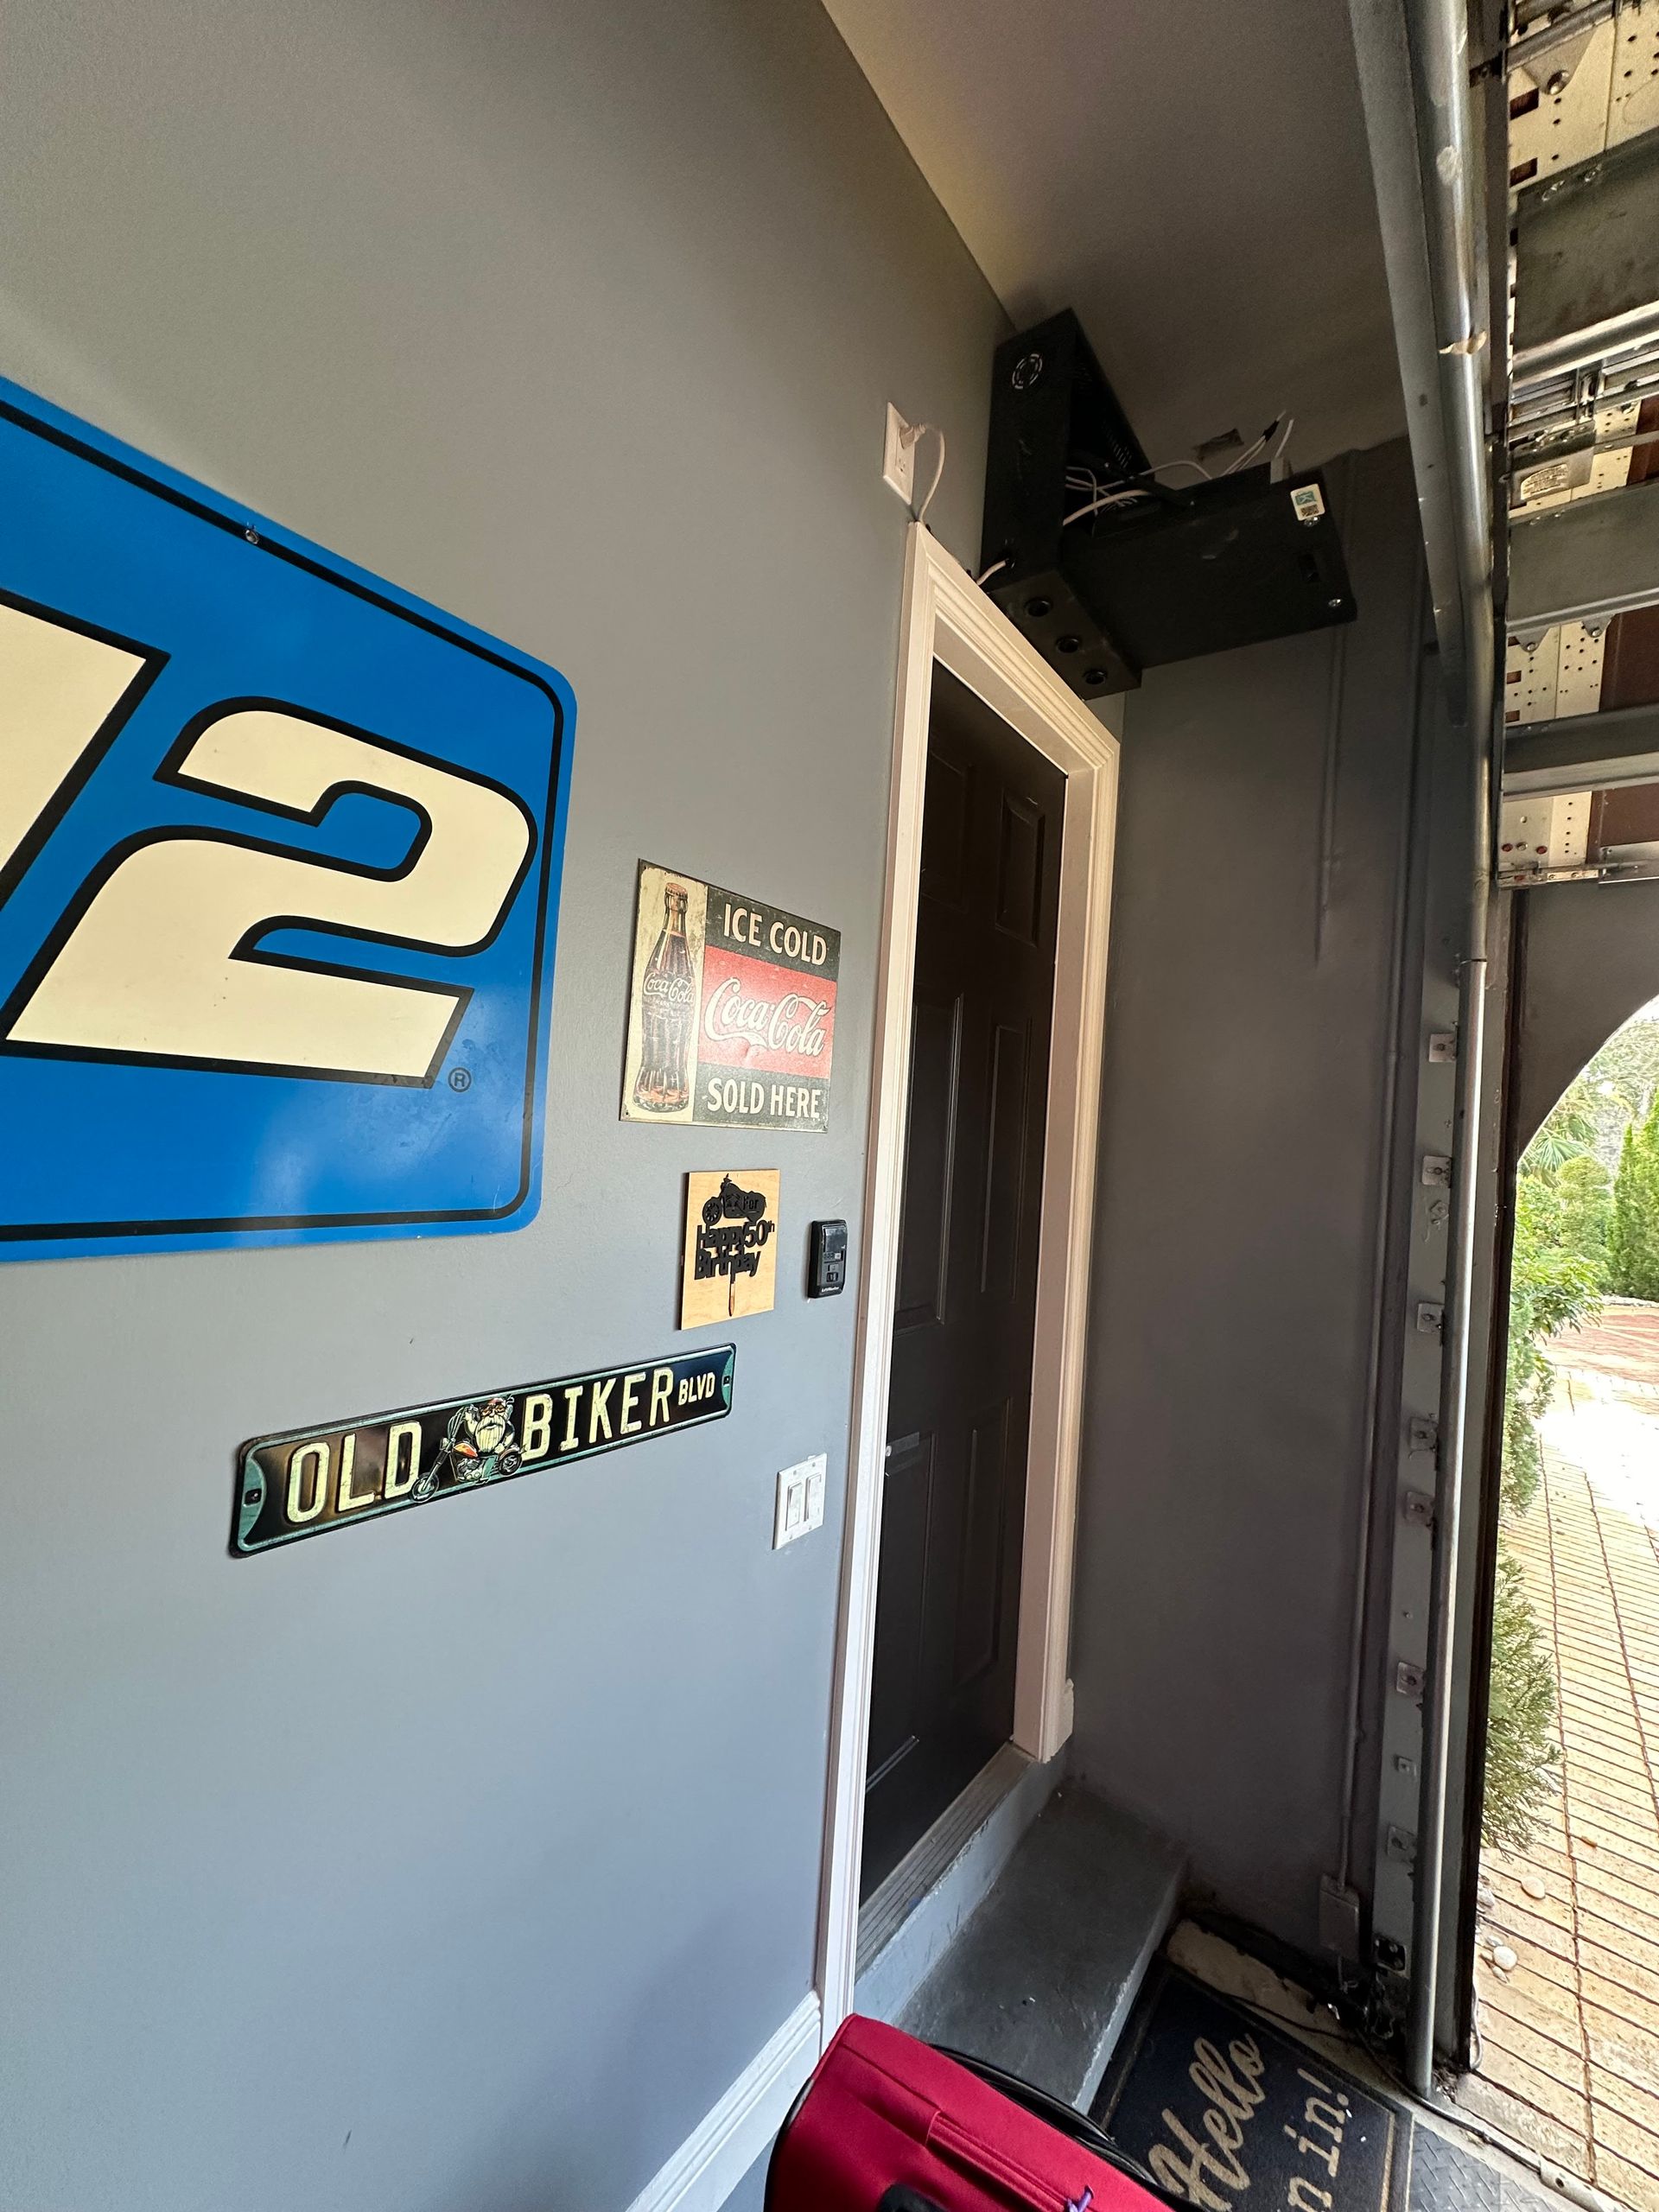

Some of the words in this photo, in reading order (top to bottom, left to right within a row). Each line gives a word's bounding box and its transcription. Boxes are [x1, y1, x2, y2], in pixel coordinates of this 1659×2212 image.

[723, 903, 763, 947] ICE
[769, 921, 827, 966] COLD
[707, 1078, 765, 1115] SOLD
[770, 1084, 822, 1119] HERE
[694, 1246, 761, 1281] Birthday
[696, 1224, 744, 1257] Happy
[285, 1419, 423, 1524] OLD
[520, 1365, 673, 1461] BIKER
[677, 1371, 716, 1407] BLVD
[1148, 2032, 1265, 2212] Hello
[1284, 2069, 1349, 2177] in!
